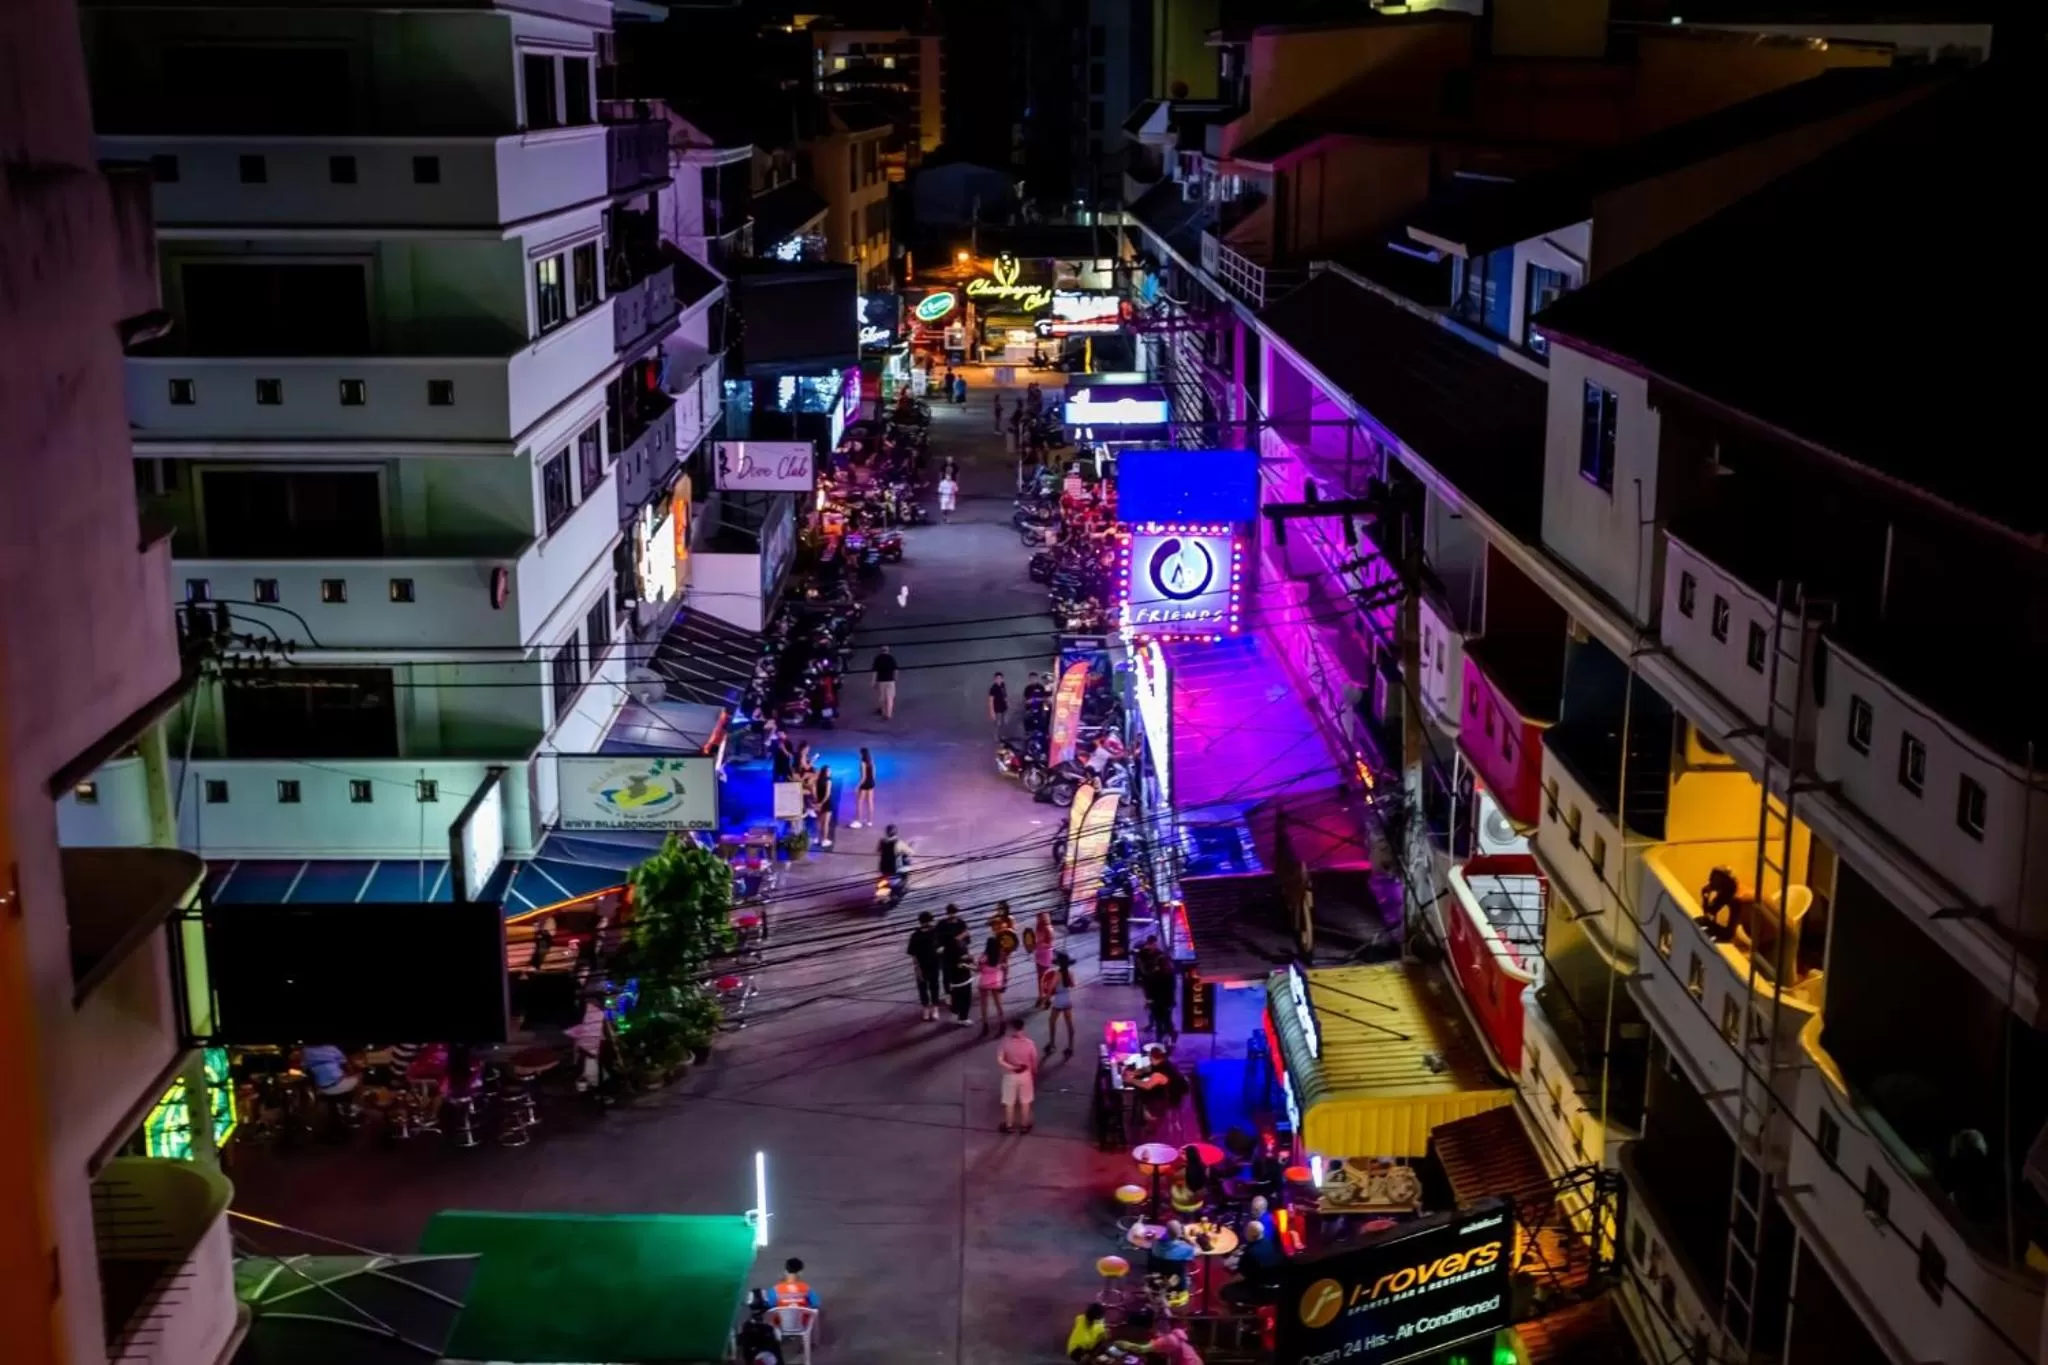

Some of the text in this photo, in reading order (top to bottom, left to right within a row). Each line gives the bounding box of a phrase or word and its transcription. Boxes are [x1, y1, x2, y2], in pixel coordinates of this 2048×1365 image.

[777, 455, 809, 480] Club
[1135, 607, 1223, 622] FRIENDS
[1347, 1296, 1390, 1316] SPORTS
[1392, 1289, 1417, 1303] BAR
[1427, 1263, 1498, 1292] RESTAURANT
[1342, 1341, 1362, 1357] 24
[1415, 1294, 1501, 1334] Conditioned
